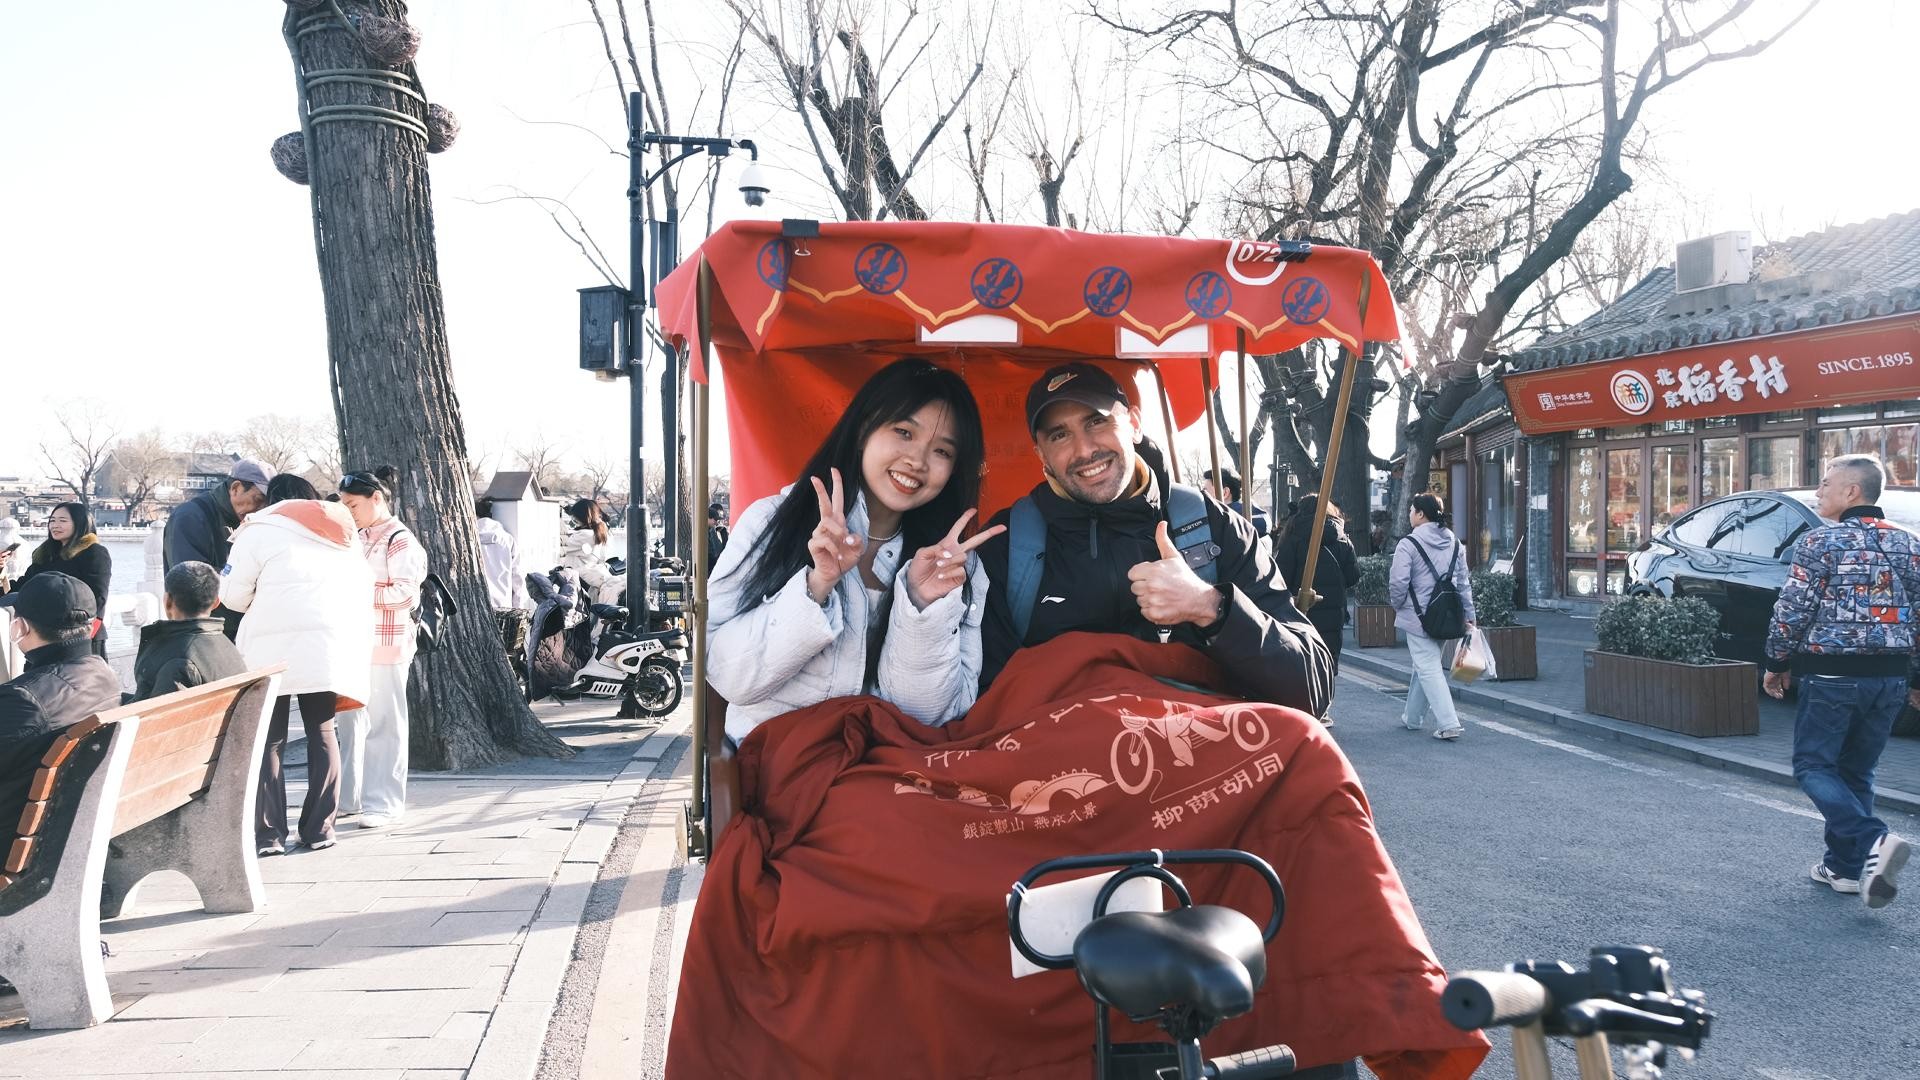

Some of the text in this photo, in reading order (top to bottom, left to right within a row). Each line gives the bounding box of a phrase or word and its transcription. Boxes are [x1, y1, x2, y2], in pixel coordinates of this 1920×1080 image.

[1678, 354, 1789, 406] 稻香村
[1817, 351, 1913, 375] SINCE.1895
[1554, 391, 1591, 402] 中华老字号
[1151, 752, 1284, 830] 柳荫胡同
